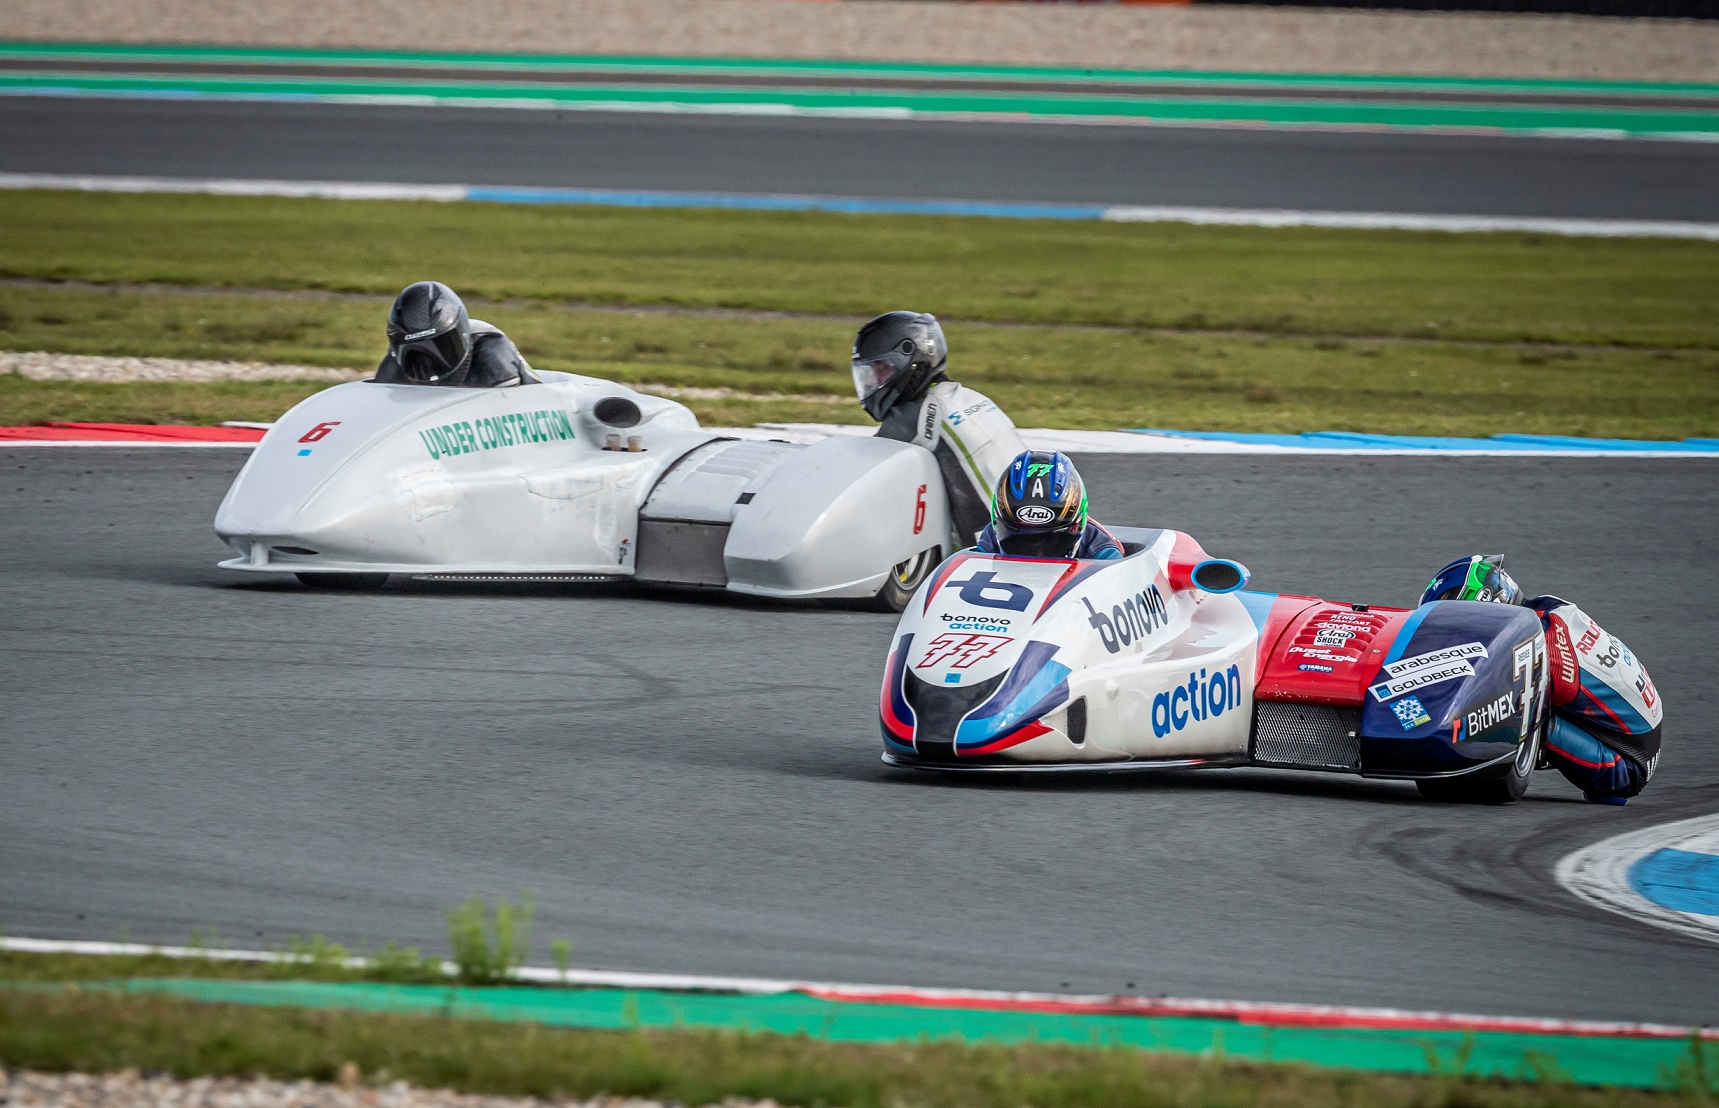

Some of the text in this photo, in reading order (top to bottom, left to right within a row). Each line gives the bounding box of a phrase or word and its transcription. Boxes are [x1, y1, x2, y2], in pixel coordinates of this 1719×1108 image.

[297, 422, 342, 443] 6
[418, 409, 576, 460] UNDER CONSTRUCTION
[924, 403, 937, 440] DAMEN
[1026, 463, 1055, 478] 77
[913, 484, 927, 535] 6
[1022, 508, 1050, 519] Arai
[940, 613, 1011, 625] bonovo
[949, 623, 1008, 633] action
[1081, 583, 1168, 654] bonovo
[1314, 621, 1371, 633] daytona
[1316, 636, 1344, 645] SHOCK
[1323, 629, 1351, 638] Arai
[915, 632, 1015, 669] 77
[1390, 645, 1483, 674] arabesque
[1555, 623, 1575, 683] wintex
[1307, 664, 1333, 672] YAMAHA
[1392, 665, 1471, 693] GOLDBECK
[1512, 629, 1549, 742] 77
[1151, 663, 1241, 739] action
[1467, 690, 1516, 737] BitMEX
